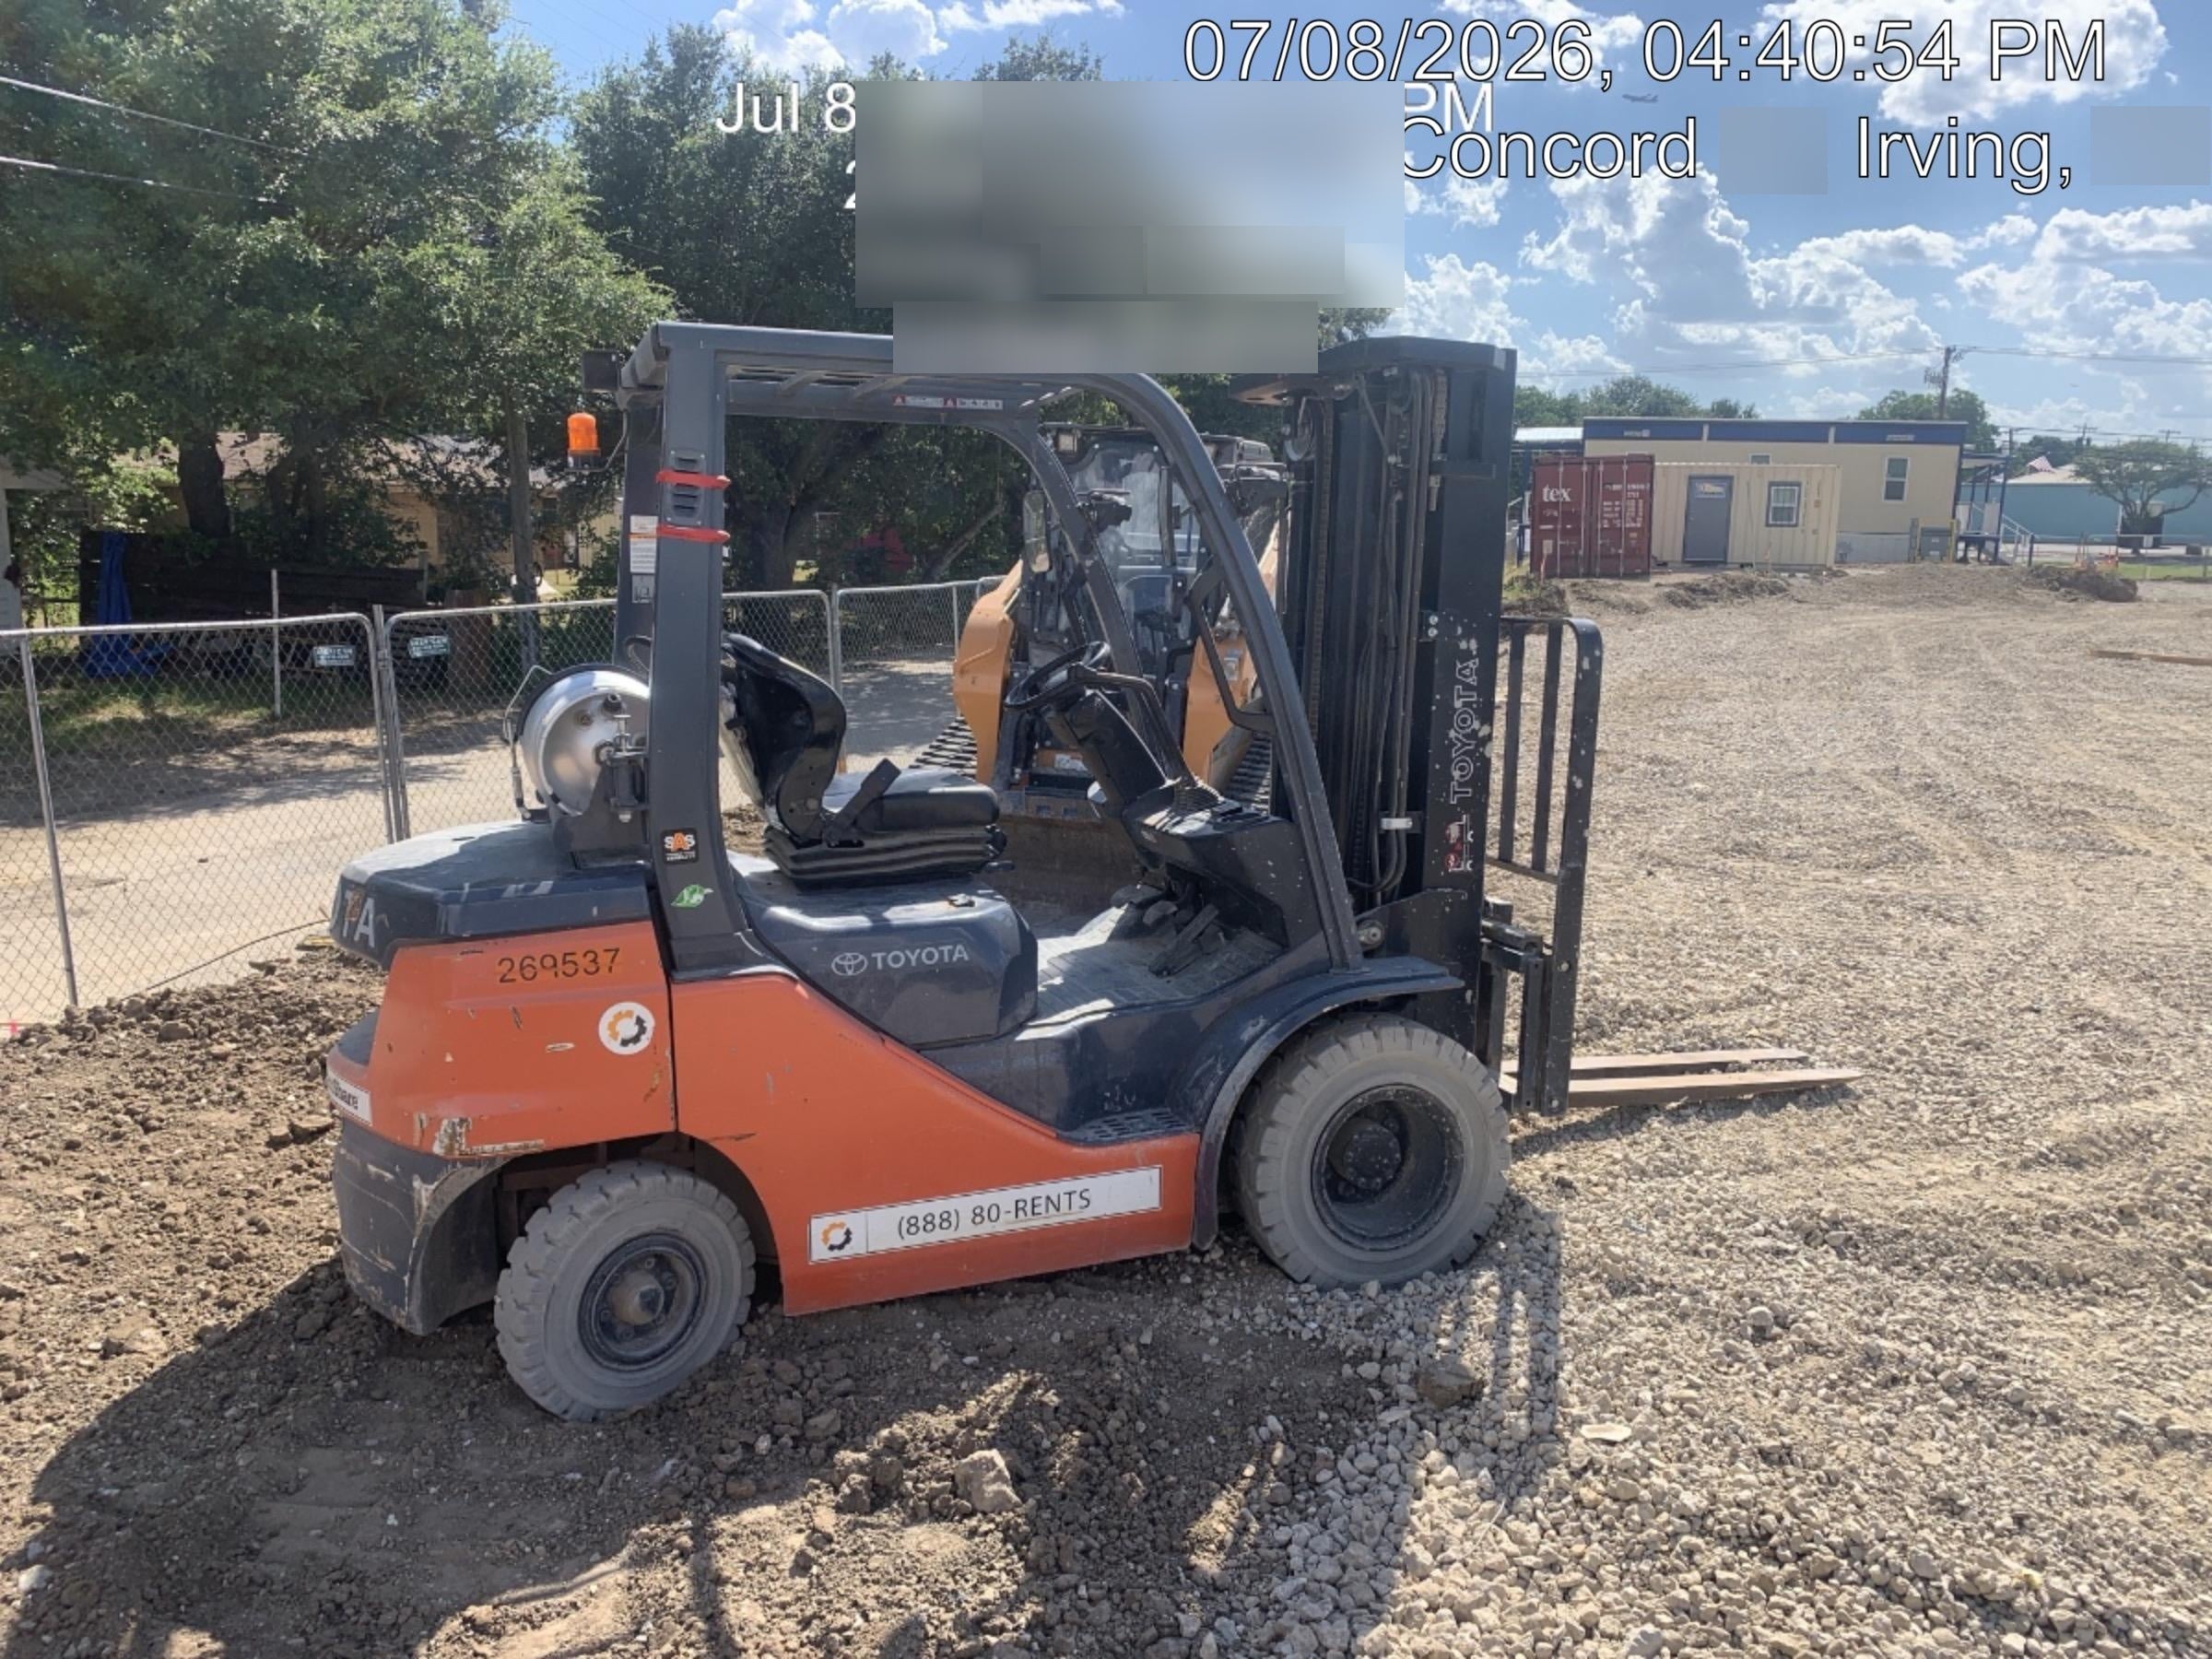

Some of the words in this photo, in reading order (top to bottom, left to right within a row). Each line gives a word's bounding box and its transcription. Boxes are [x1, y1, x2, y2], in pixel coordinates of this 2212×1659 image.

[1542, 485, 1571, 502] tex
[1450, 658, 1479, 804] TOYOTA
[498, 947, 620, 983] 269537
[871, 944, 970, 971] TOYOTA
[898, 1209, 960, 1240] (888)
[971, 1189, 1091, 1226] 80-RENTS
